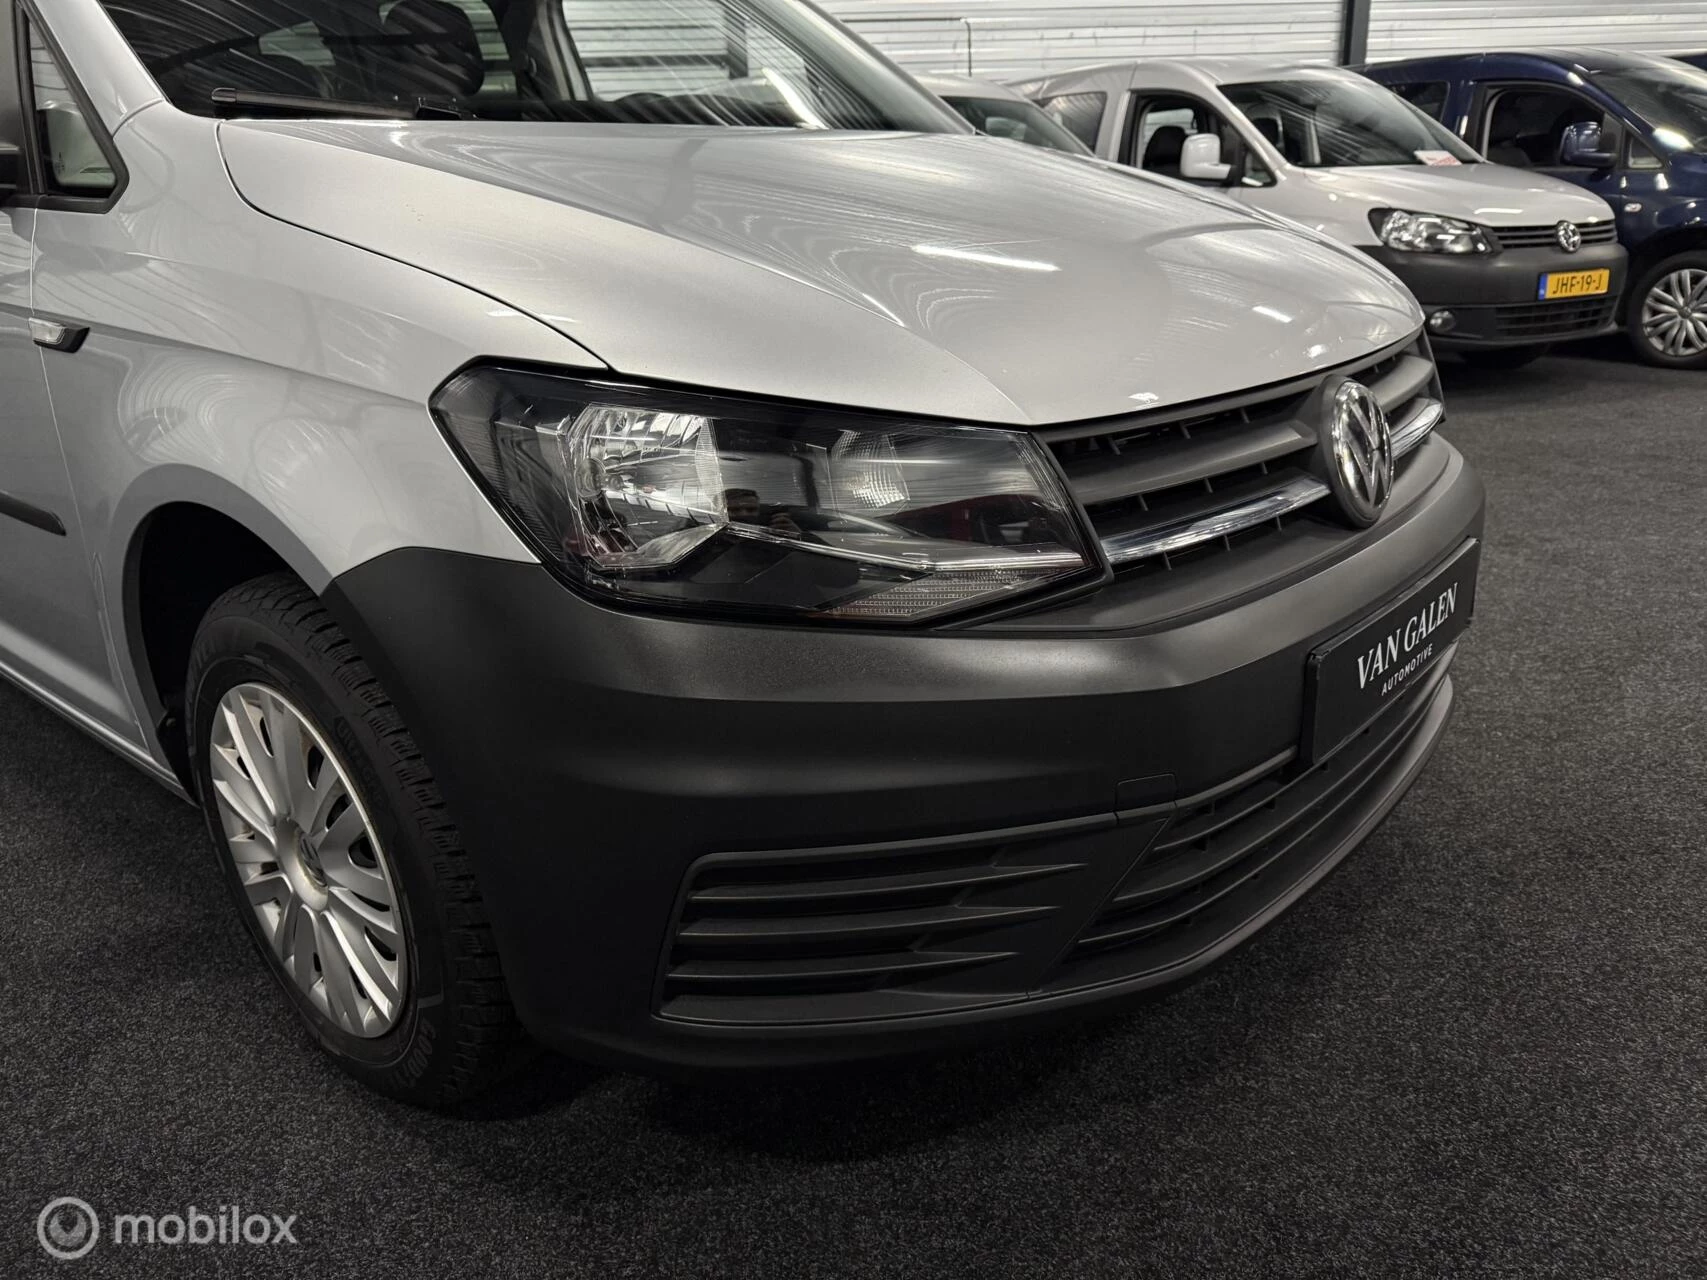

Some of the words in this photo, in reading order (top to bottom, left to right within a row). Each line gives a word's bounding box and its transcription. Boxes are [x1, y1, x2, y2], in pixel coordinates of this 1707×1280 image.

[1552, 273, 1604, 295] JHF-19-J
[1357, 629, 1401, 689] VAN
[1404, 582, 1458, 652] GALEN
[1381, 643, 1433, 696] AUTOMOTIVE
